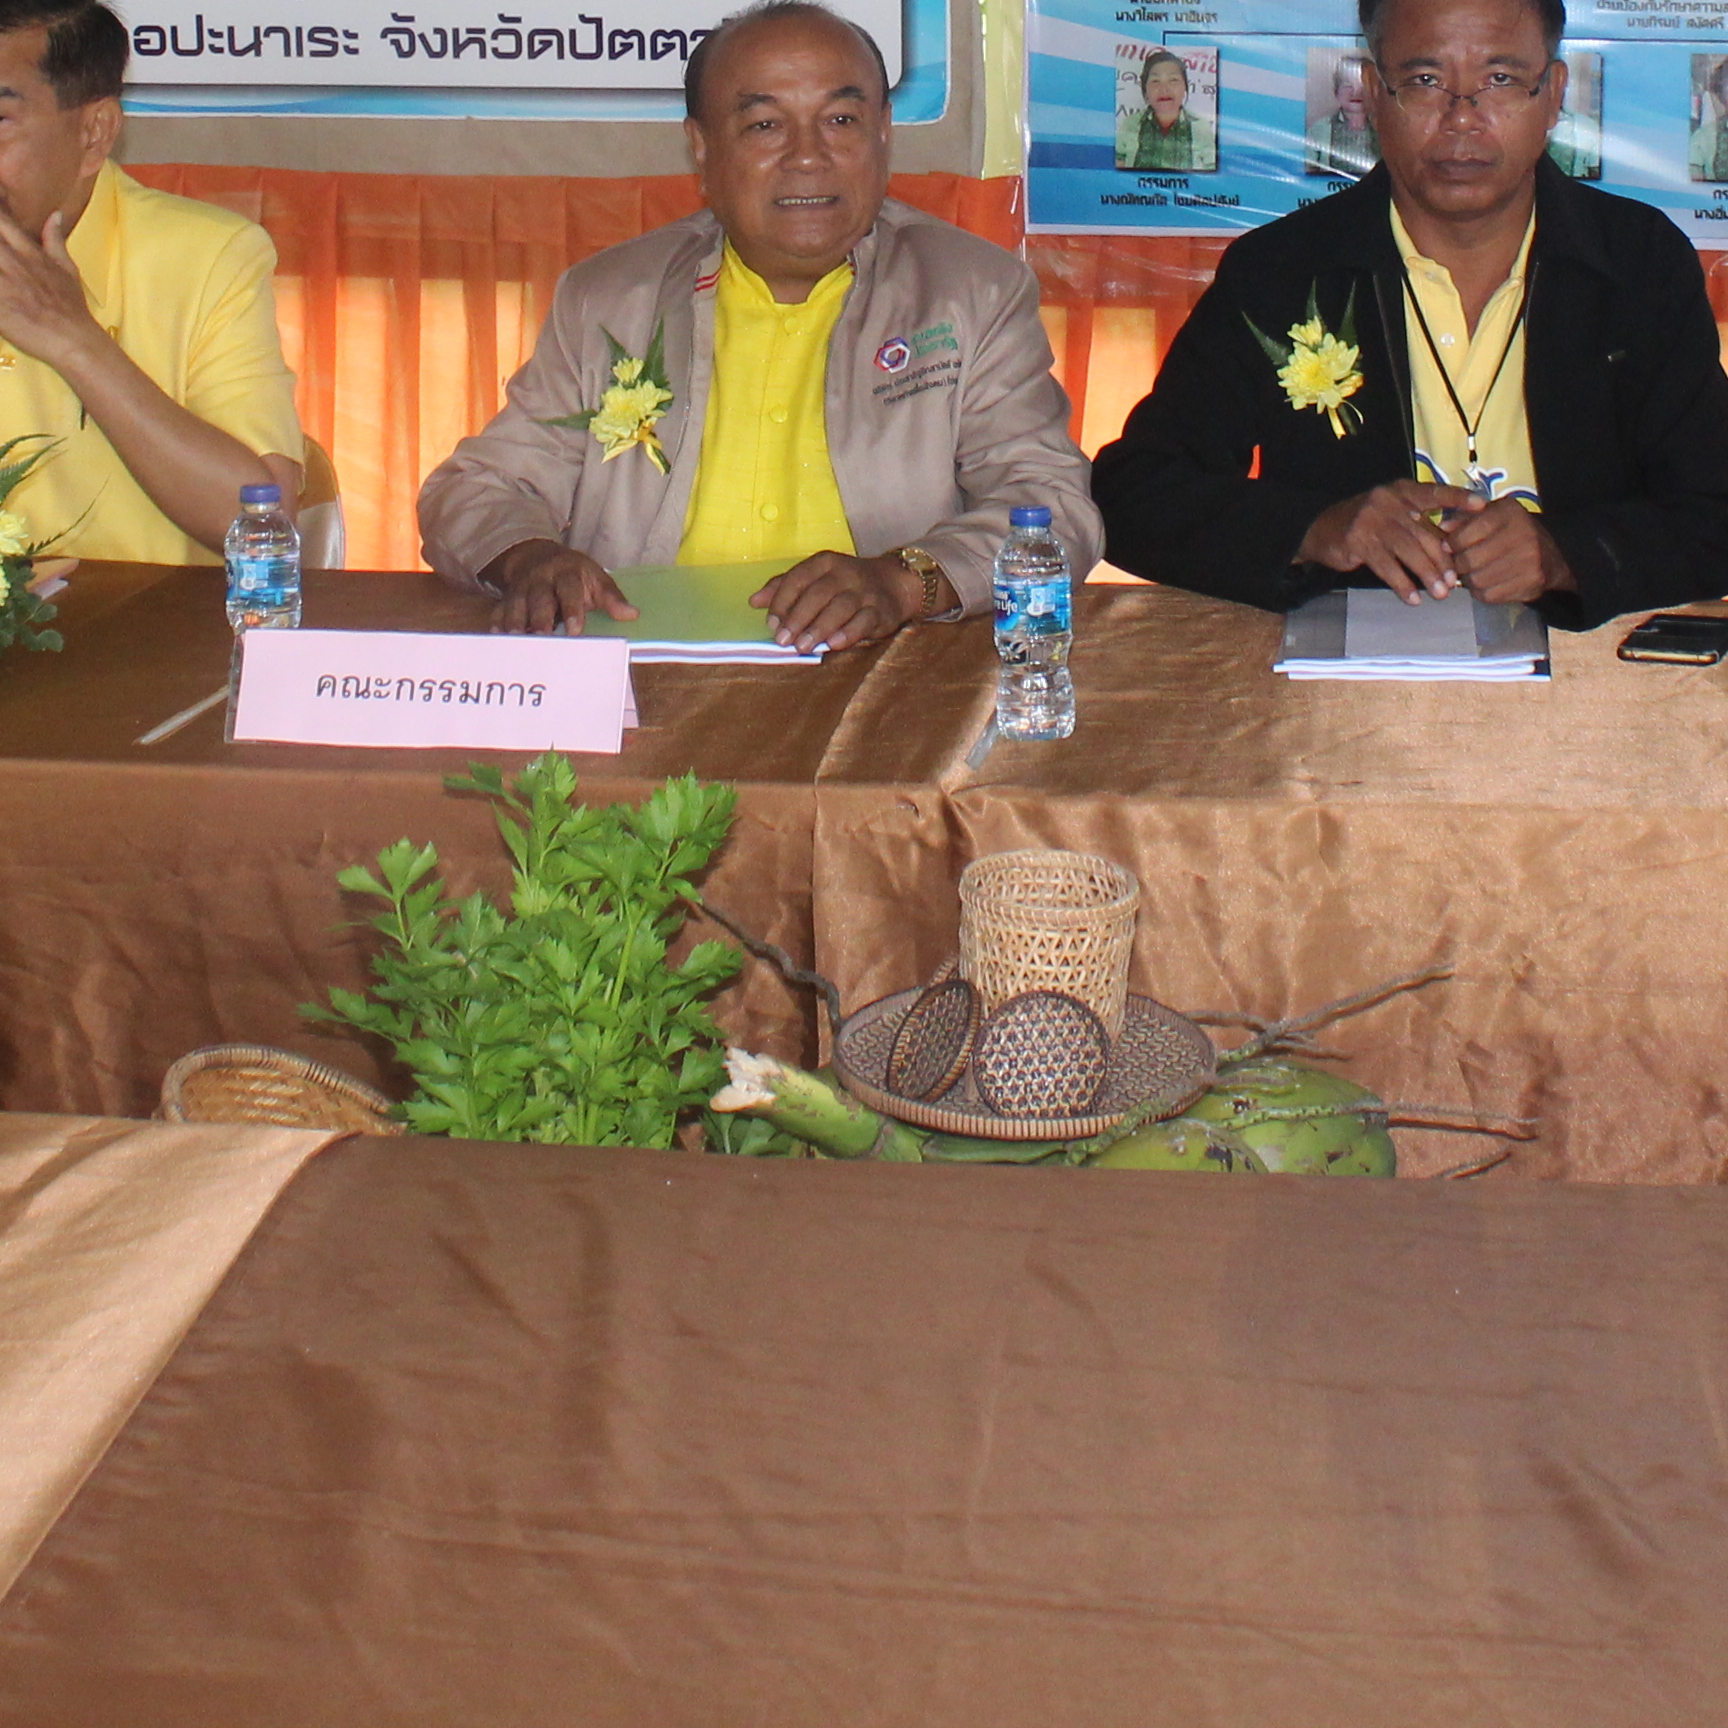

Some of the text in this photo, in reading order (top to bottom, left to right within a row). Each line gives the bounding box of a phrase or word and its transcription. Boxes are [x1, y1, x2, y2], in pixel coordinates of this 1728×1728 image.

[1138, 177, 1189, 189] กรรมการ
[315, 667, 546, 710] คณะกรรมการ
